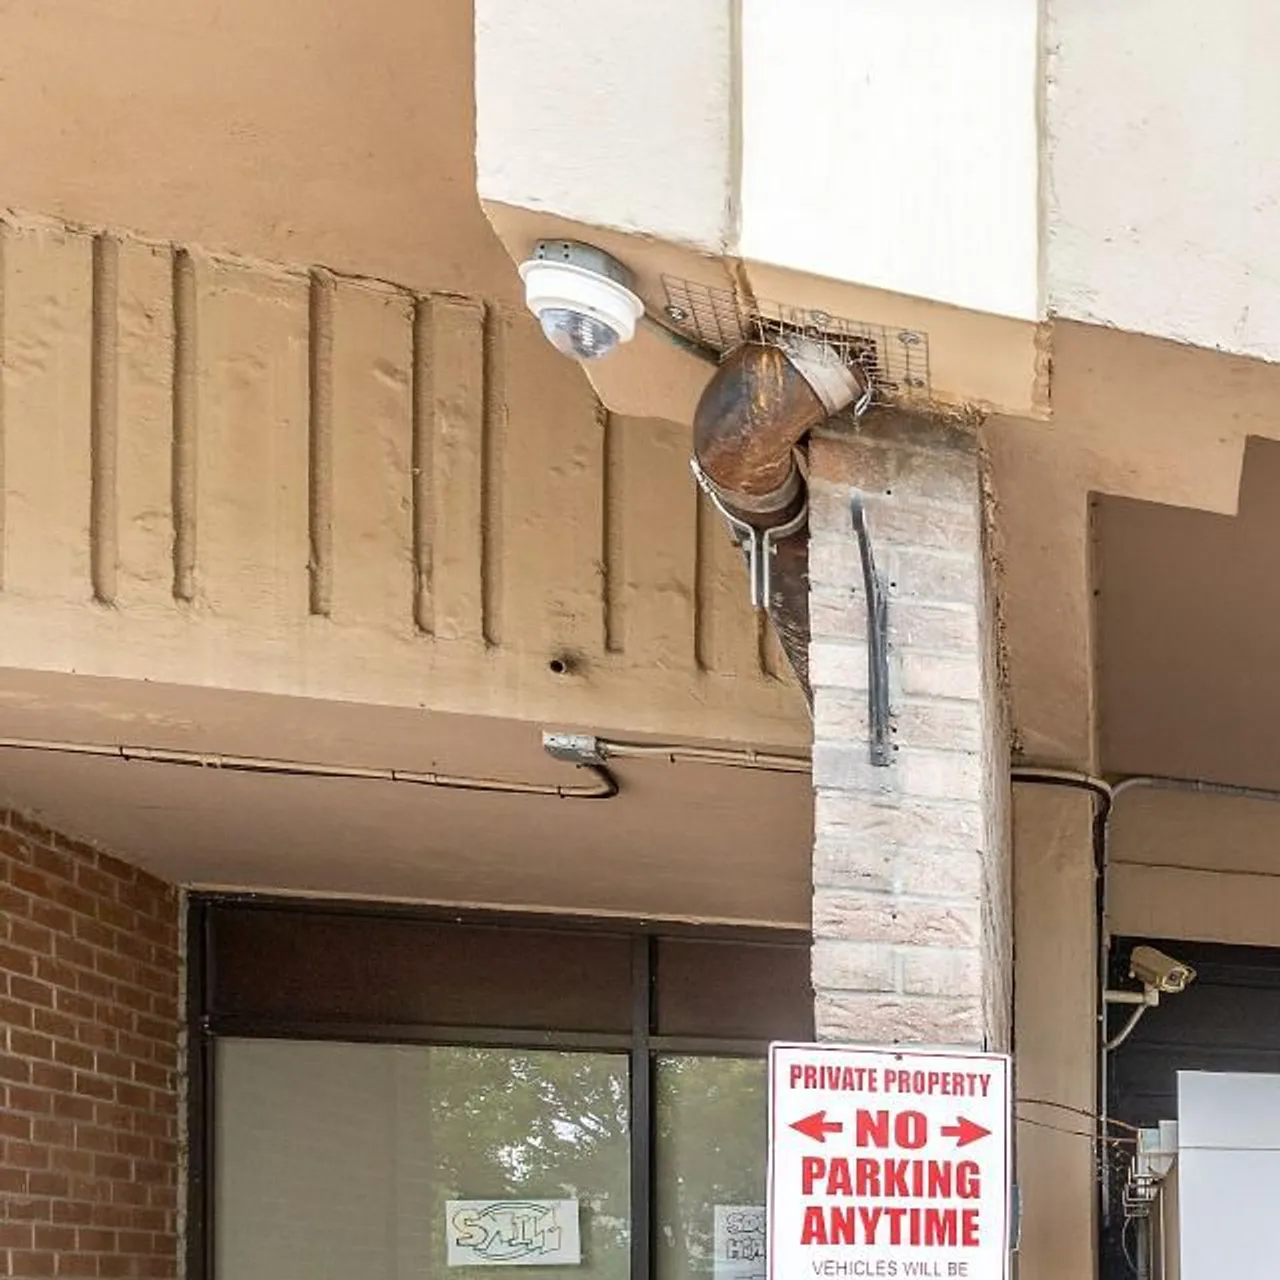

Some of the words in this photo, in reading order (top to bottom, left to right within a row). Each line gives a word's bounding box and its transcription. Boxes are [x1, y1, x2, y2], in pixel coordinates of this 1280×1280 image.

[790, 1064, 877, 1092] PRIVATE
[884, 1068, 991, 1097] PROPERTY
[856, 1109, 927, 1149] NO
[801, 1156, 981, 1199] PARKING
[800, 1206, 980, 1246] ANYTIME
[812, 1260, 898, 1277] VEHICLES
[903, 1261, 942, 1277] WILL
[947, 1261, 969, 1277] BE
